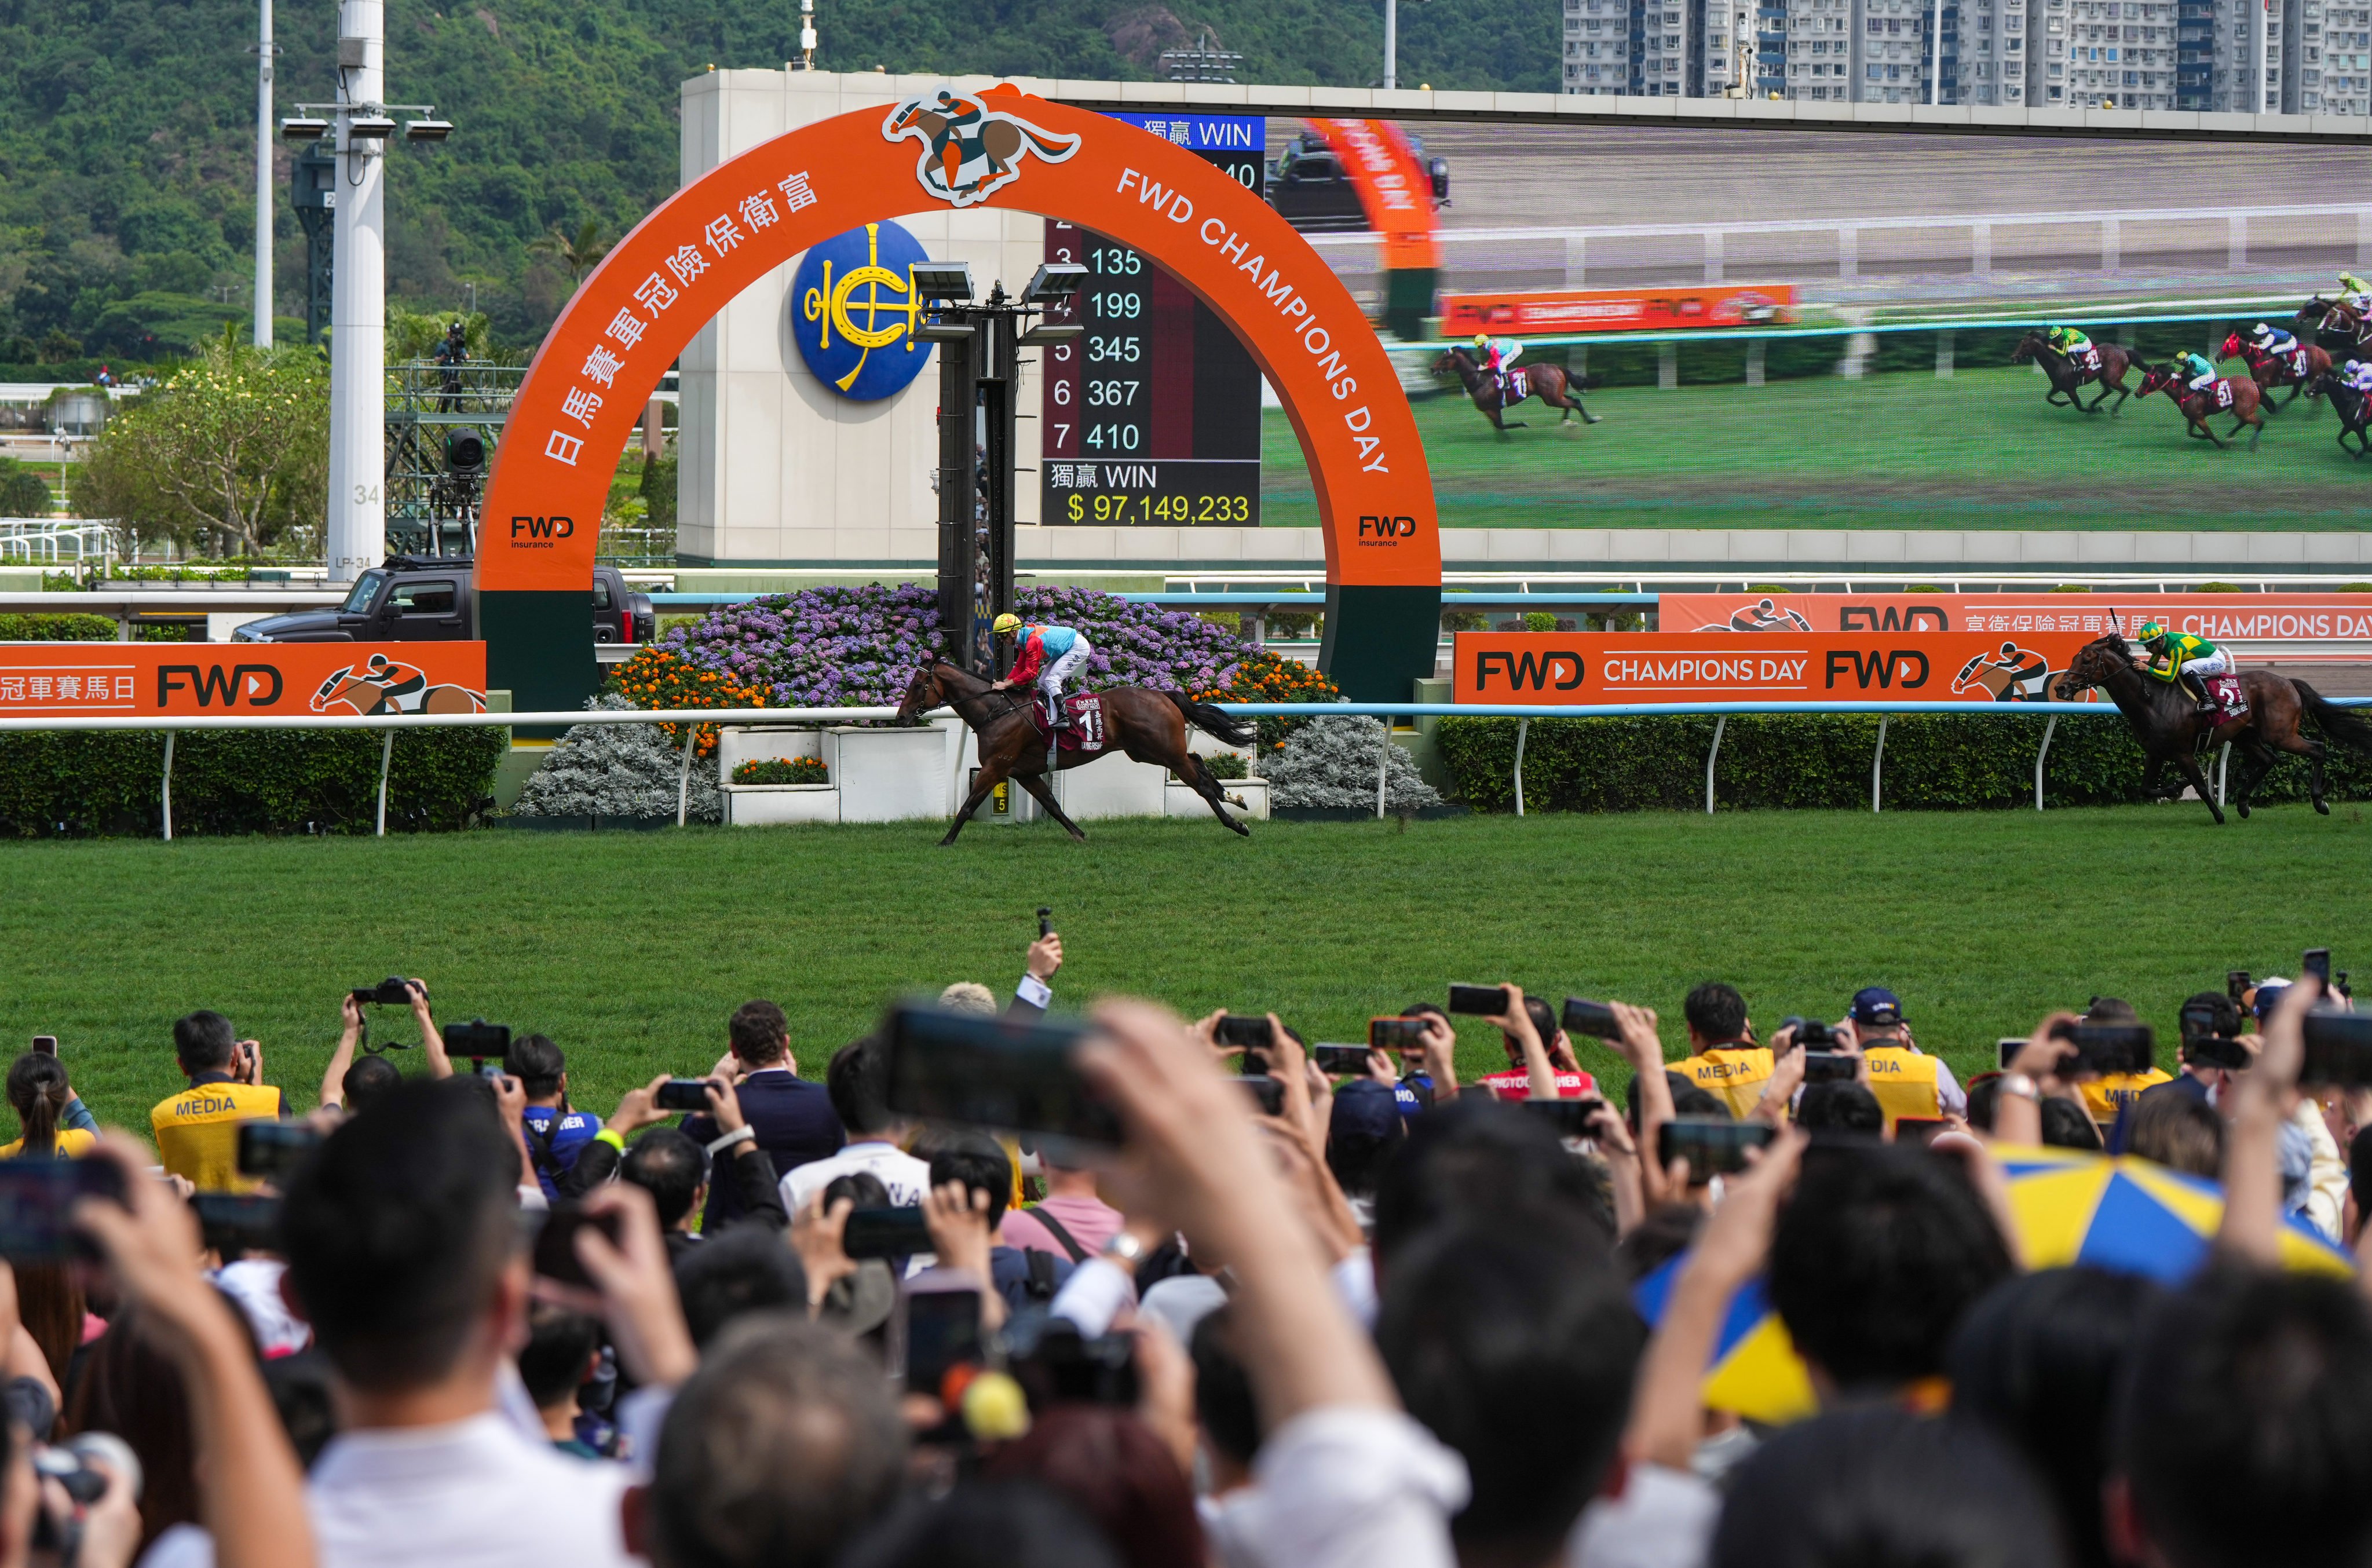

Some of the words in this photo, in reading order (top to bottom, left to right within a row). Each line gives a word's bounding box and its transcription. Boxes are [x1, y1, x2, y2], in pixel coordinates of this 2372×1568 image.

[1199, 122, 1251, 146] WIN
[1092, 248, 1141, 275] 135
[1091, 293, 1141, 318] 199
[1117, 167, 1193, 223] FWD
[1201, 218, 1357, 400] CHAMPIONS
[1344, 406, 1389, 473] DAY
[1089, 336, 1140, 362] 345
[1054, 380, 1071, 405] 6
[1088, 380, 1139, 405] 367
[1054, 424, 1070, 449] 7
[1087, 424, 1139, 449] 410
[1051, 463, 1098, 488] 獨贏
[1106, 465, 1157, 488] WIN
[354, 484, 379, 505] 34
[1094, 495, 1249, 525] 97,149,233
[511, 516, 574, 538] FWD
[1359, 516, 1416, 537] FWD
[511, 540, 554, 549] insurance
[336, 557, 371, 568] LP-34
[1840, 606, 1949, 631] FWD
[2183, 615, 2330, 637] CHAMPIONS
[1476, 651, 1585, 690] FWD
[1604, 659, 1753, 681] CHAMPIONS
[1760, 659, 1808, 680] DAY
[1826, 650, 1929, 689] FWD
[0, 675, 135, 701] 冠軍賽馬日
[158, 664, 283, 707] FWD
[2219, 688, 2235, 712] 2
[1079, 711, 1092, 741] 1
[999, 799, 1006, 811] 5
[1698, 1062, 1750, 1079] MEDIA
[176, 1096, 236, 1116] MEDIA
